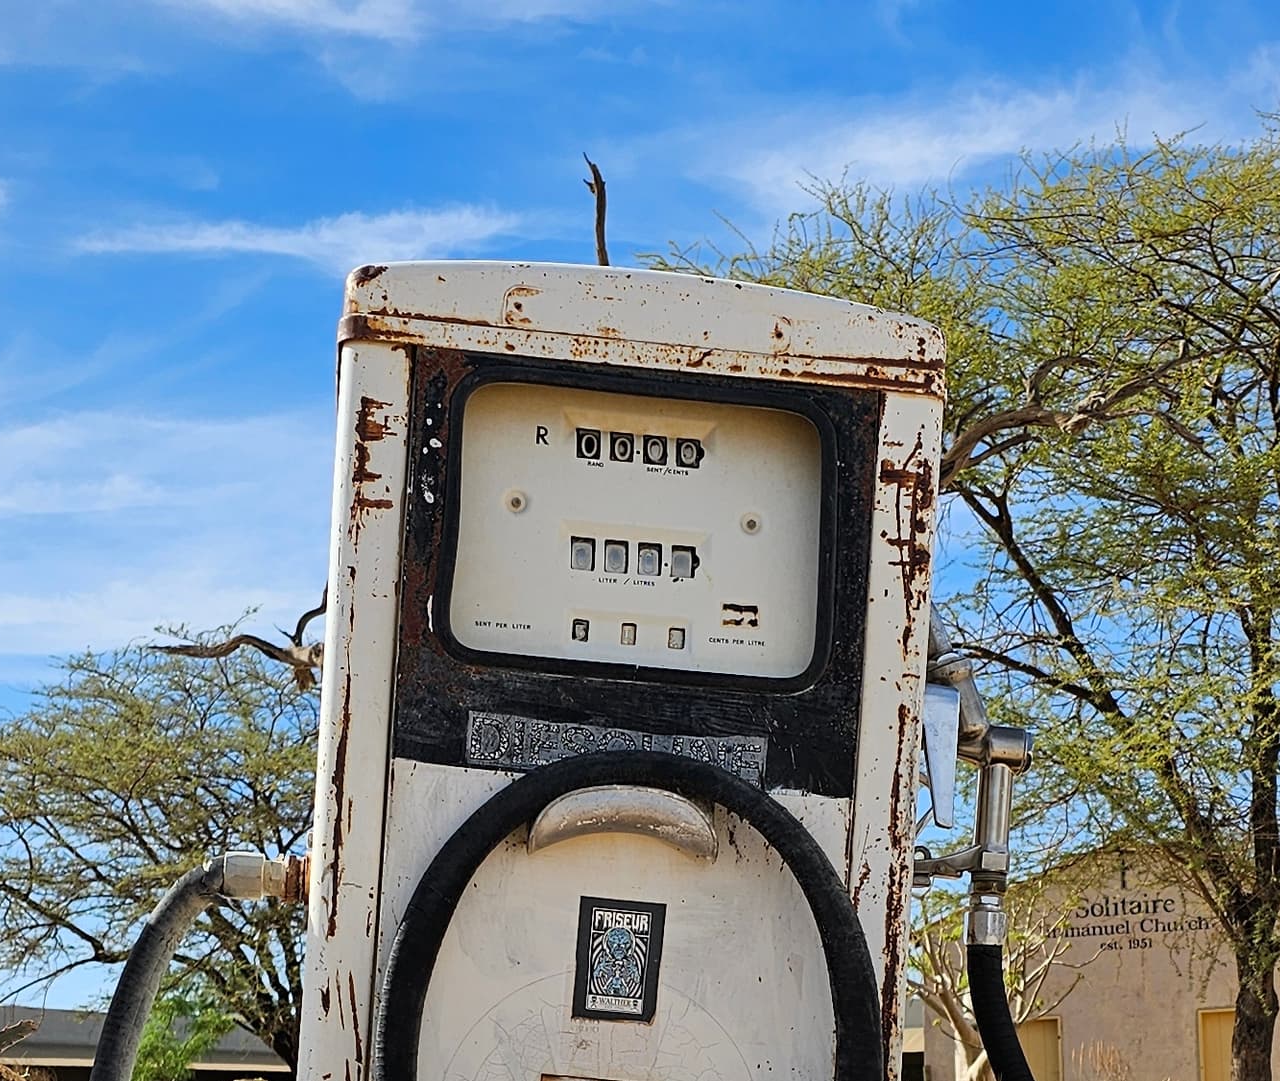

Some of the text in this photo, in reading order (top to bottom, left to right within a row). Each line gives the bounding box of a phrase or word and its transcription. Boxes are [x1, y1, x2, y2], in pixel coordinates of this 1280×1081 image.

[535, 425, 549, 445] R
[1076, 893, 1175, 918] Solitaire
[595, 910, 649, 931] FRISEUR
[1038, 916, 1210, 939] mmanuel Church
[1100, 938, 1152, 950] est. 1951
